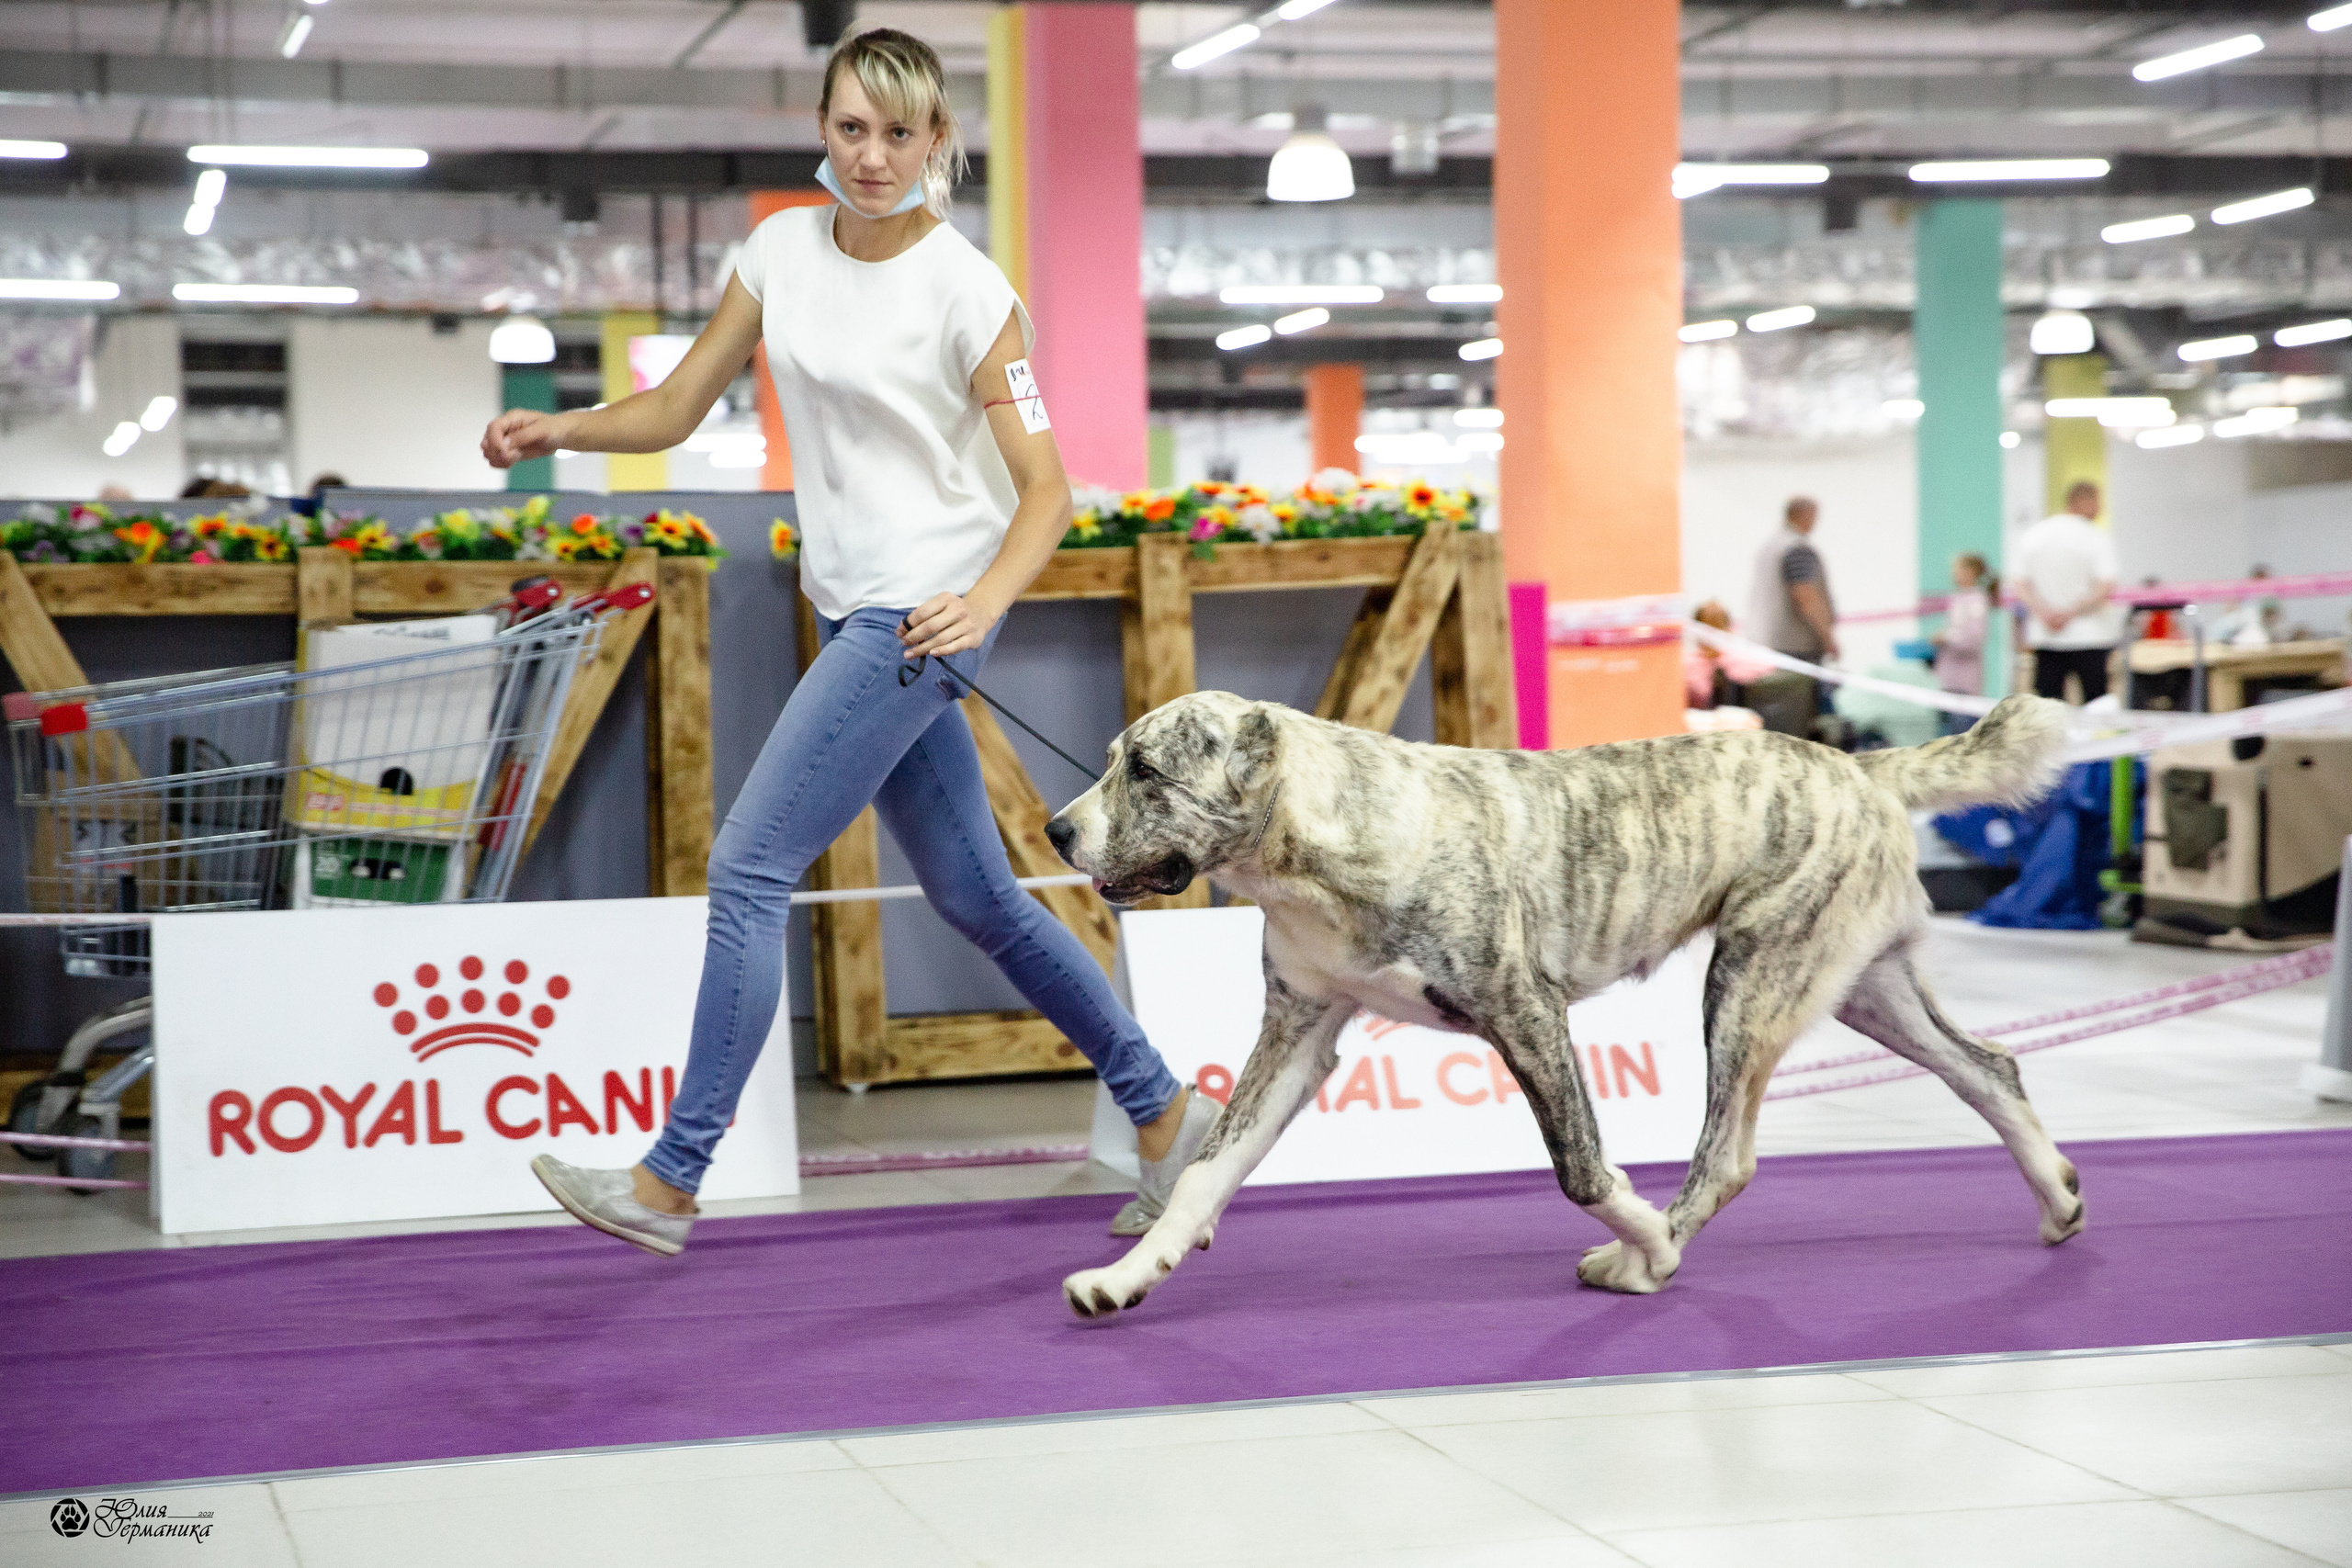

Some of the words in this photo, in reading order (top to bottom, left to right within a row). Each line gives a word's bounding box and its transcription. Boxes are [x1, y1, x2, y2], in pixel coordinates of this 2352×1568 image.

[208, 1078, 464, 1157] ROYAL
[484, 1066, 736, 1141] CANI
[1436, 1041, 1661, 1106] CAIN
